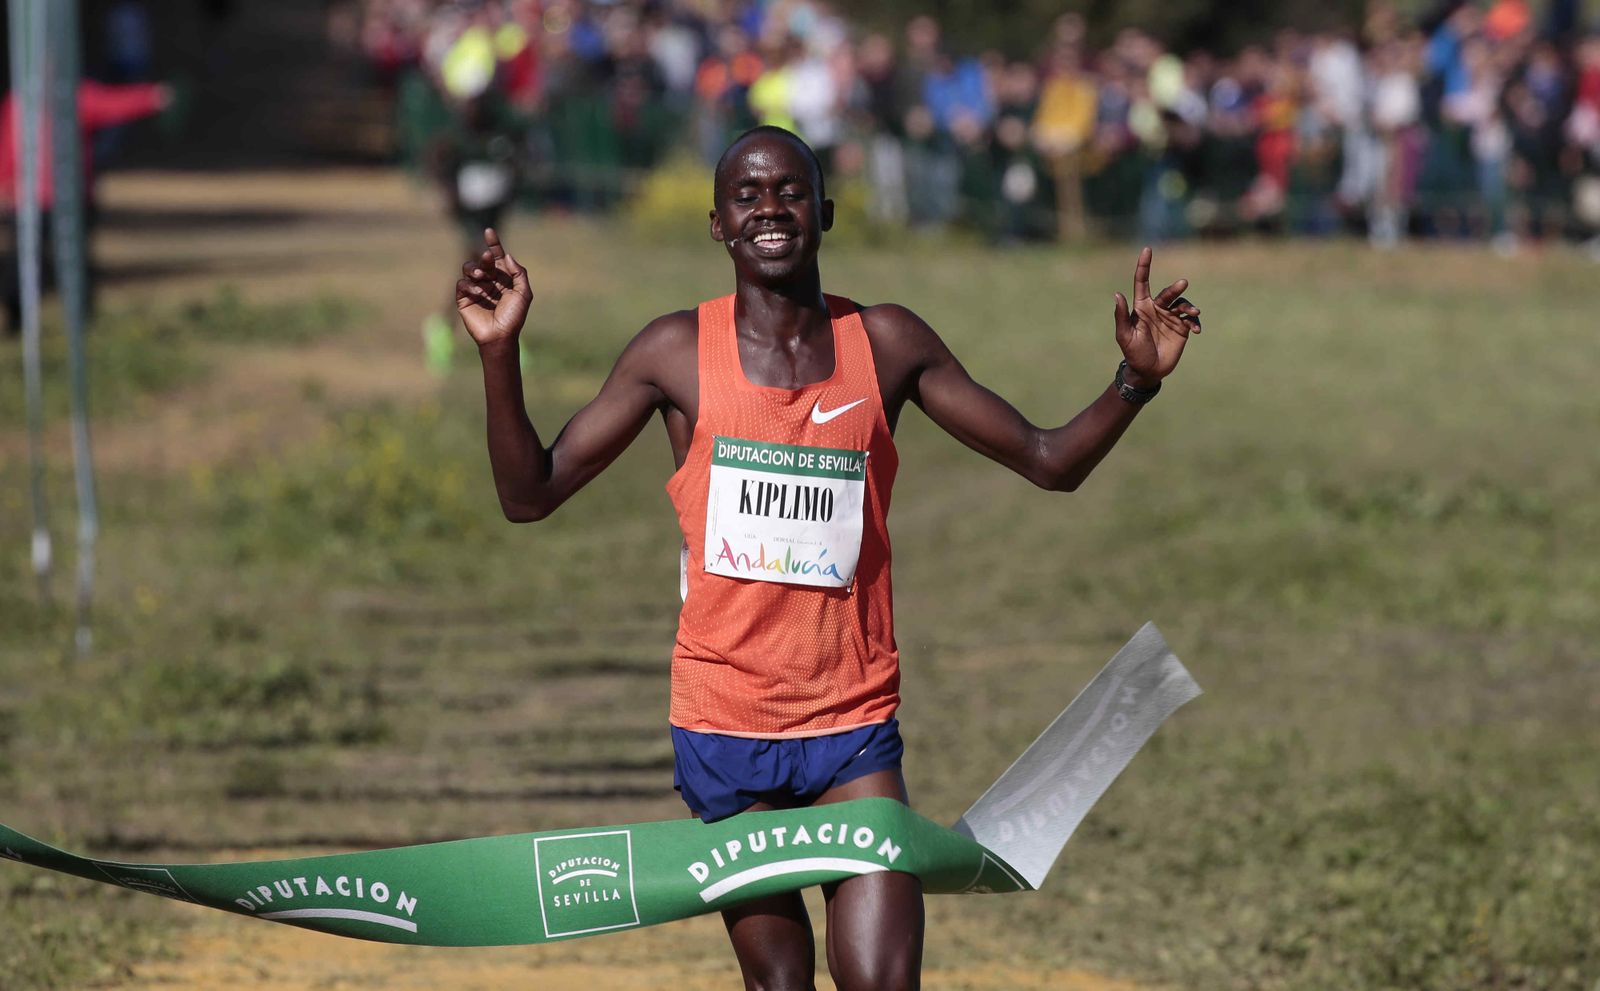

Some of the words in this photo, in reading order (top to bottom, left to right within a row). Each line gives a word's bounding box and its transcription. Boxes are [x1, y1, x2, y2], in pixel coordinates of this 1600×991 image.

[718, 444, 794, 467] DIPUTACION
[798, 453, 815, 469] DE
[818, 454, 861, 473] SEVILLA
[738, 479, 834, 523] KIPLIMO
[715, 537, 844, 581] Andalucía
[548, 856, 620, 878] DIPUTACION
[688, 823, 902, 884] DIPUTACION
[235, 875, 417, 917] DIPUTACION
[554, 888, 620, 907] SEVILLA
[580, 878, 591, 887] DE
